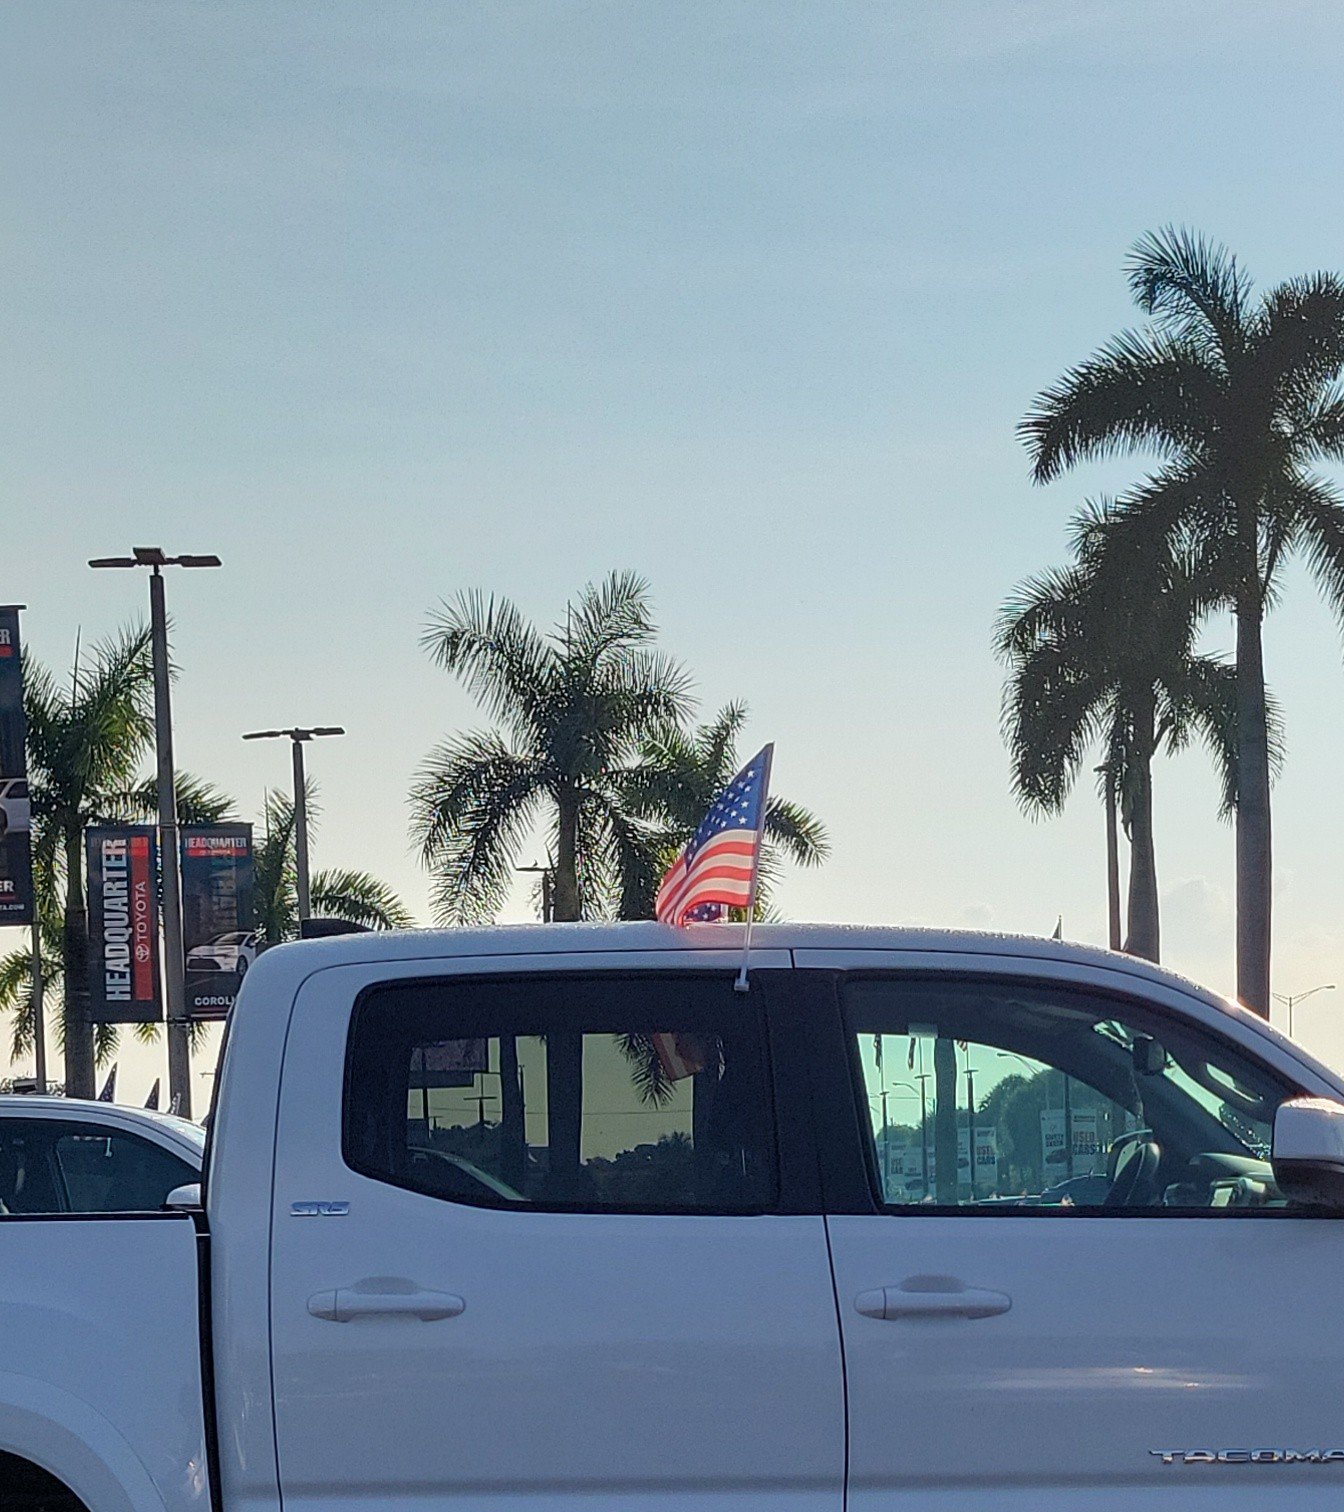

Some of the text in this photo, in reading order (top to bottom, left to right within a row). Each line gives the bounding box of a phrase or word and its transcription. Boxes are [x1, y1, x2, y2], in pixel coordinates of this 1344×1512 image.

[184, 837, 247, 849] HEADQUARTER
[102, 838, 133, 1000] HEADQUARTER
[135, 881, 148, 942] TOYOTA
[290, 1201, 350, 1217] SR5
